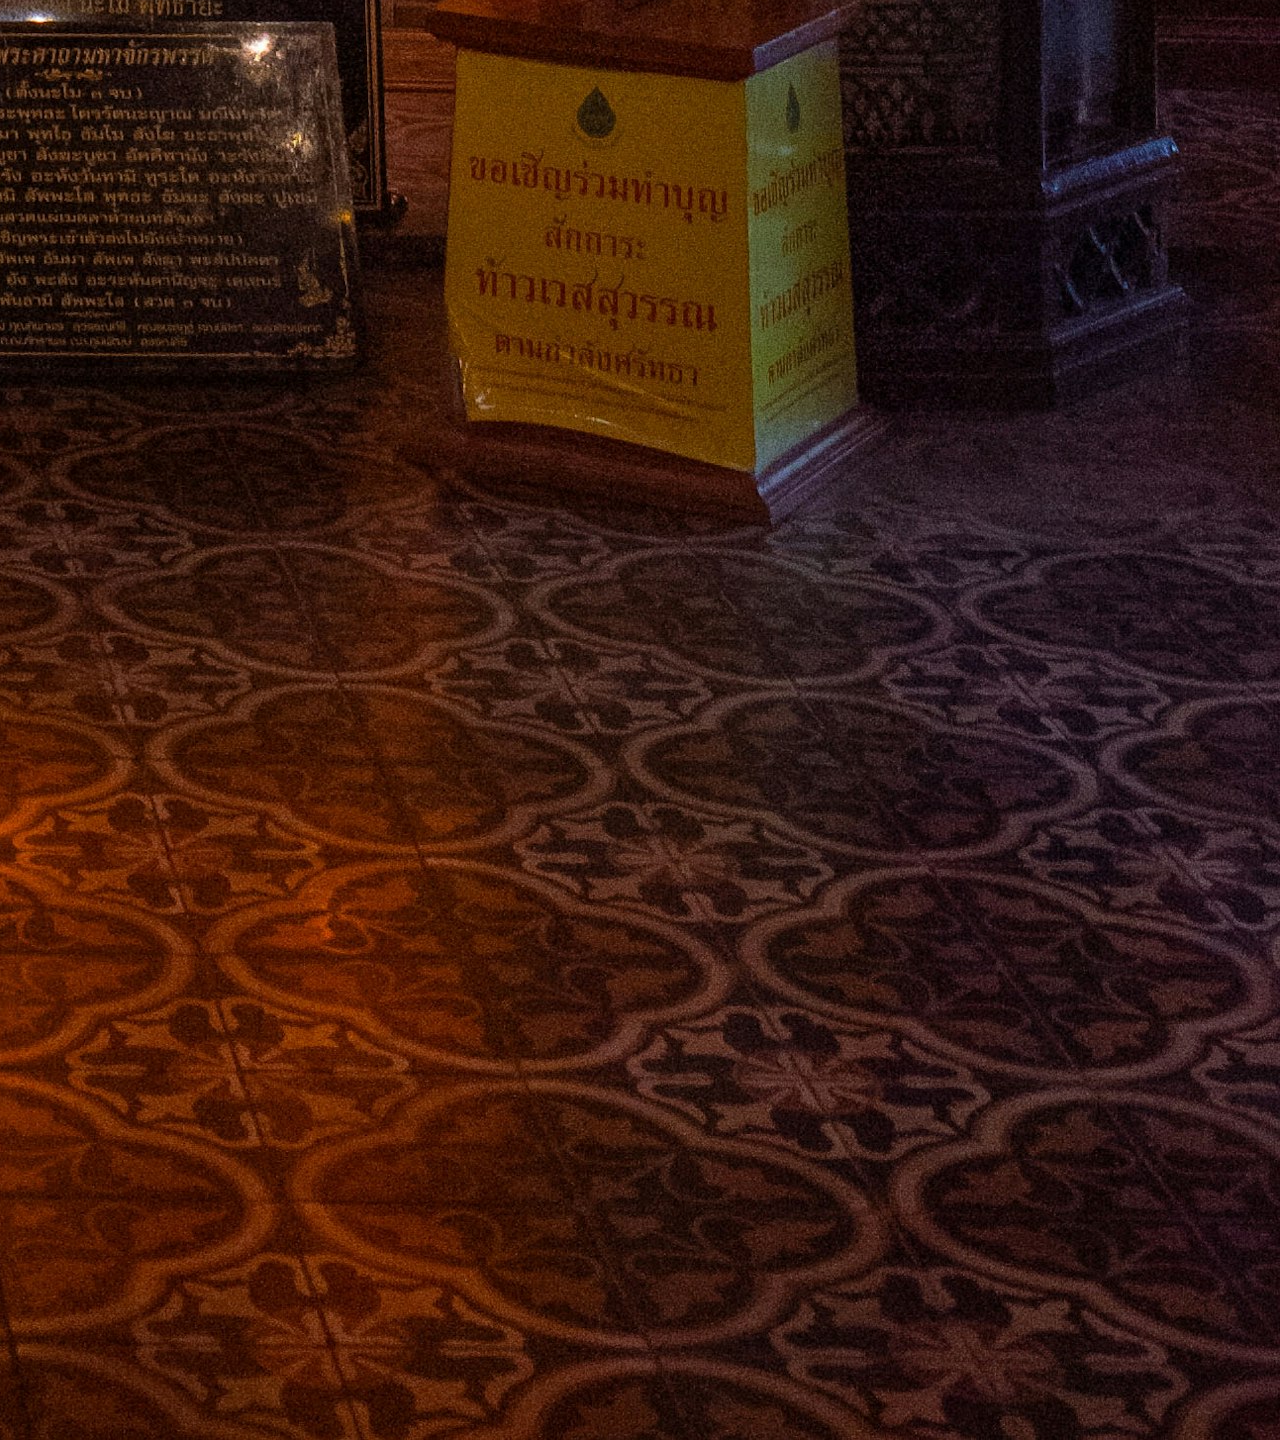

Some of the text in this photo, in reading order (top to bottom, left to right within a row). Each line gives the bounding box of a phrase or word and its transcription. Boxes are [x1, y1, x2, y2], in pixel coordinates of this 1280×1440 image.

[468, 150, 729, 224] ขอเชิญร่วมทำบุญ
[543, 214, 648, 263] สักการะ
[476, 256, 719, 333] ท้าวเวสสุวรรณ
